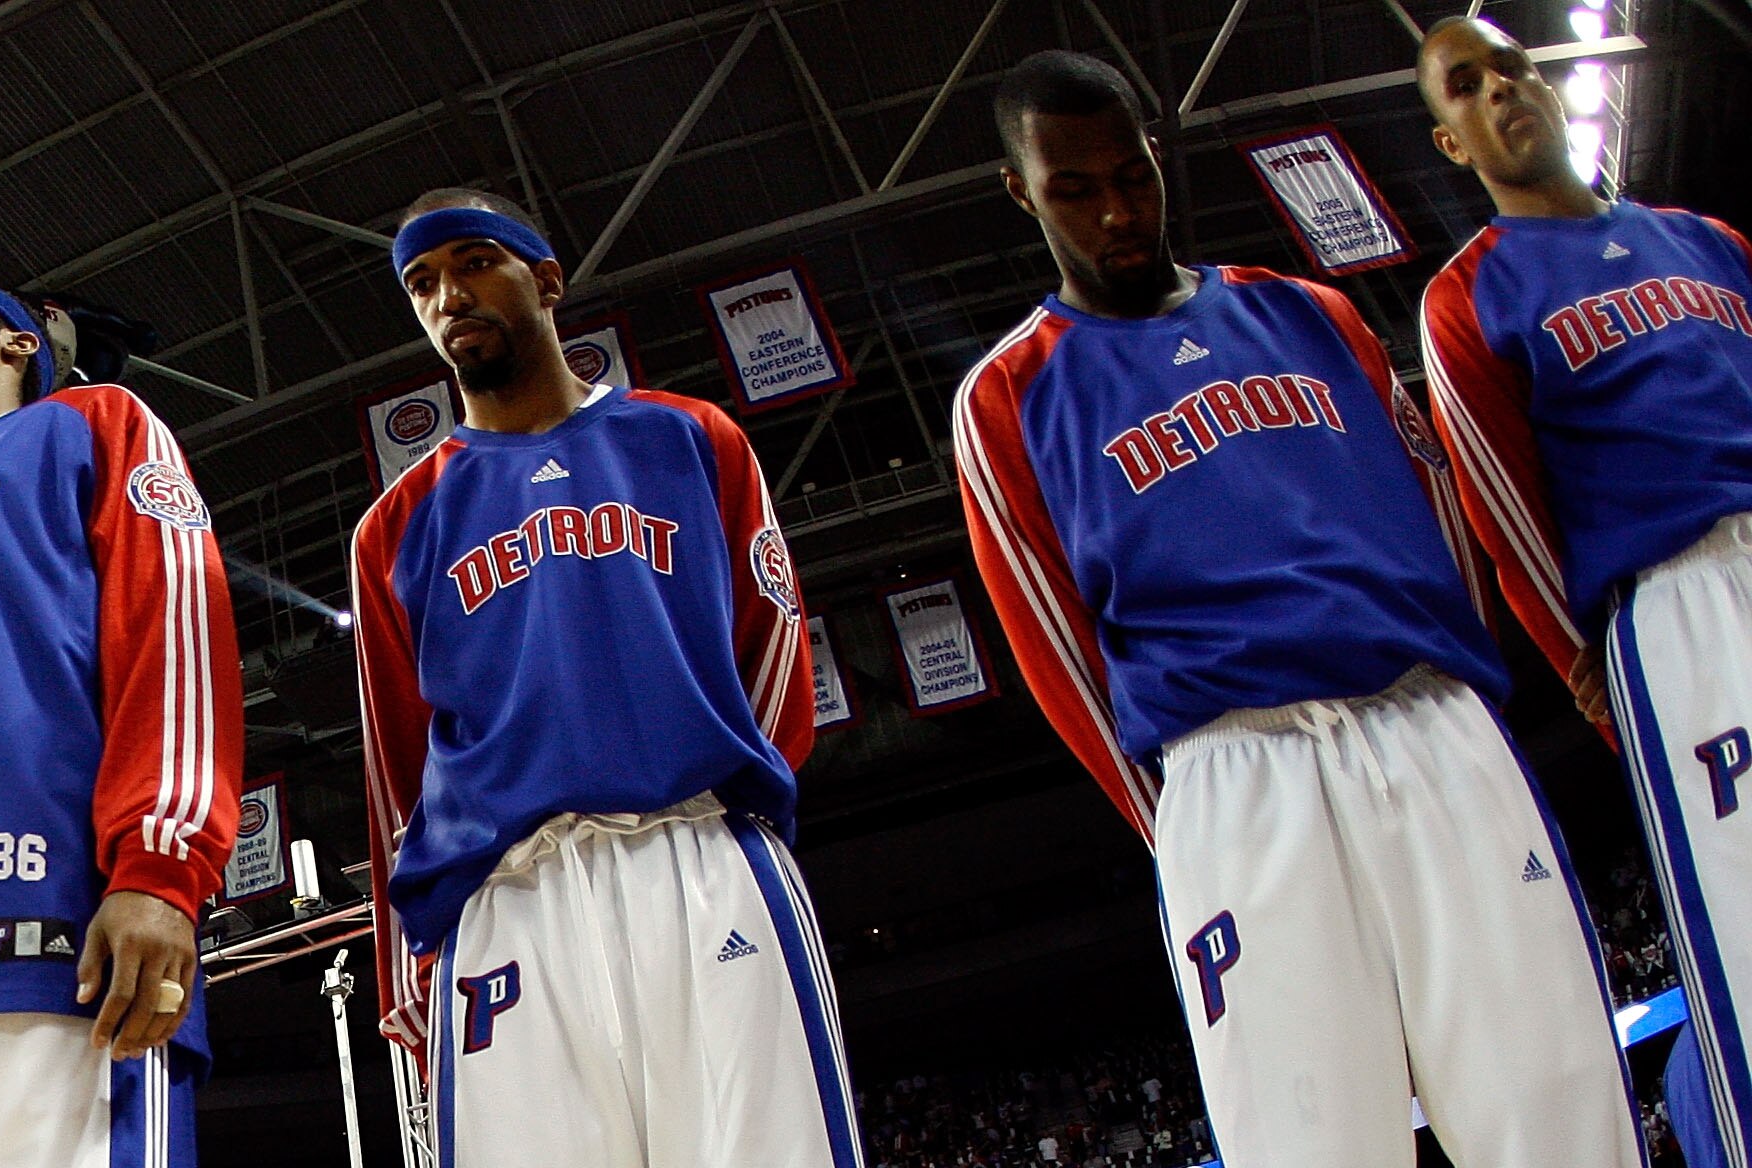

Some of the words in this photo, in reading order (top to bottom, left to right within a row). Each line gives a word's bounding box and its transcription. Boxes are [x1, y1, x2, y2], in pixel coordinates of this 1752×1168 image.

[1268, 150, 1332, 173] PISTONS
[1312, 207, 1363, 227] EASTERN
[1309, 218, 1385, 242] CONFERENCE
[724, 287, 793, 319] PISTONS
[1542, 277, 1752, 371] DETROIT
[757, 329, 785, 344] 2004
[749, 336, 804, 361] EASTERN
[741, 345, 825, 378] CONFERENCE
[751, 360, 825, 390] CHAMPIONS
[1103, 374, 1346, 495] DETROIT
[408, 442, 430, 457] 1989
[531, 469, 570, 484] adidas
[152, 481, 193, 510] 50
[448, 501, 679, 616] DETROIT
[919, 650, 964, 669] CENTRAL
[924, 662, 967, 681] DIVISION
[921, 673, 978, 695] CHAMPIONS
[237, 849, 268, 866] CENTRAL
[717, 944, 759, 963] adidas
